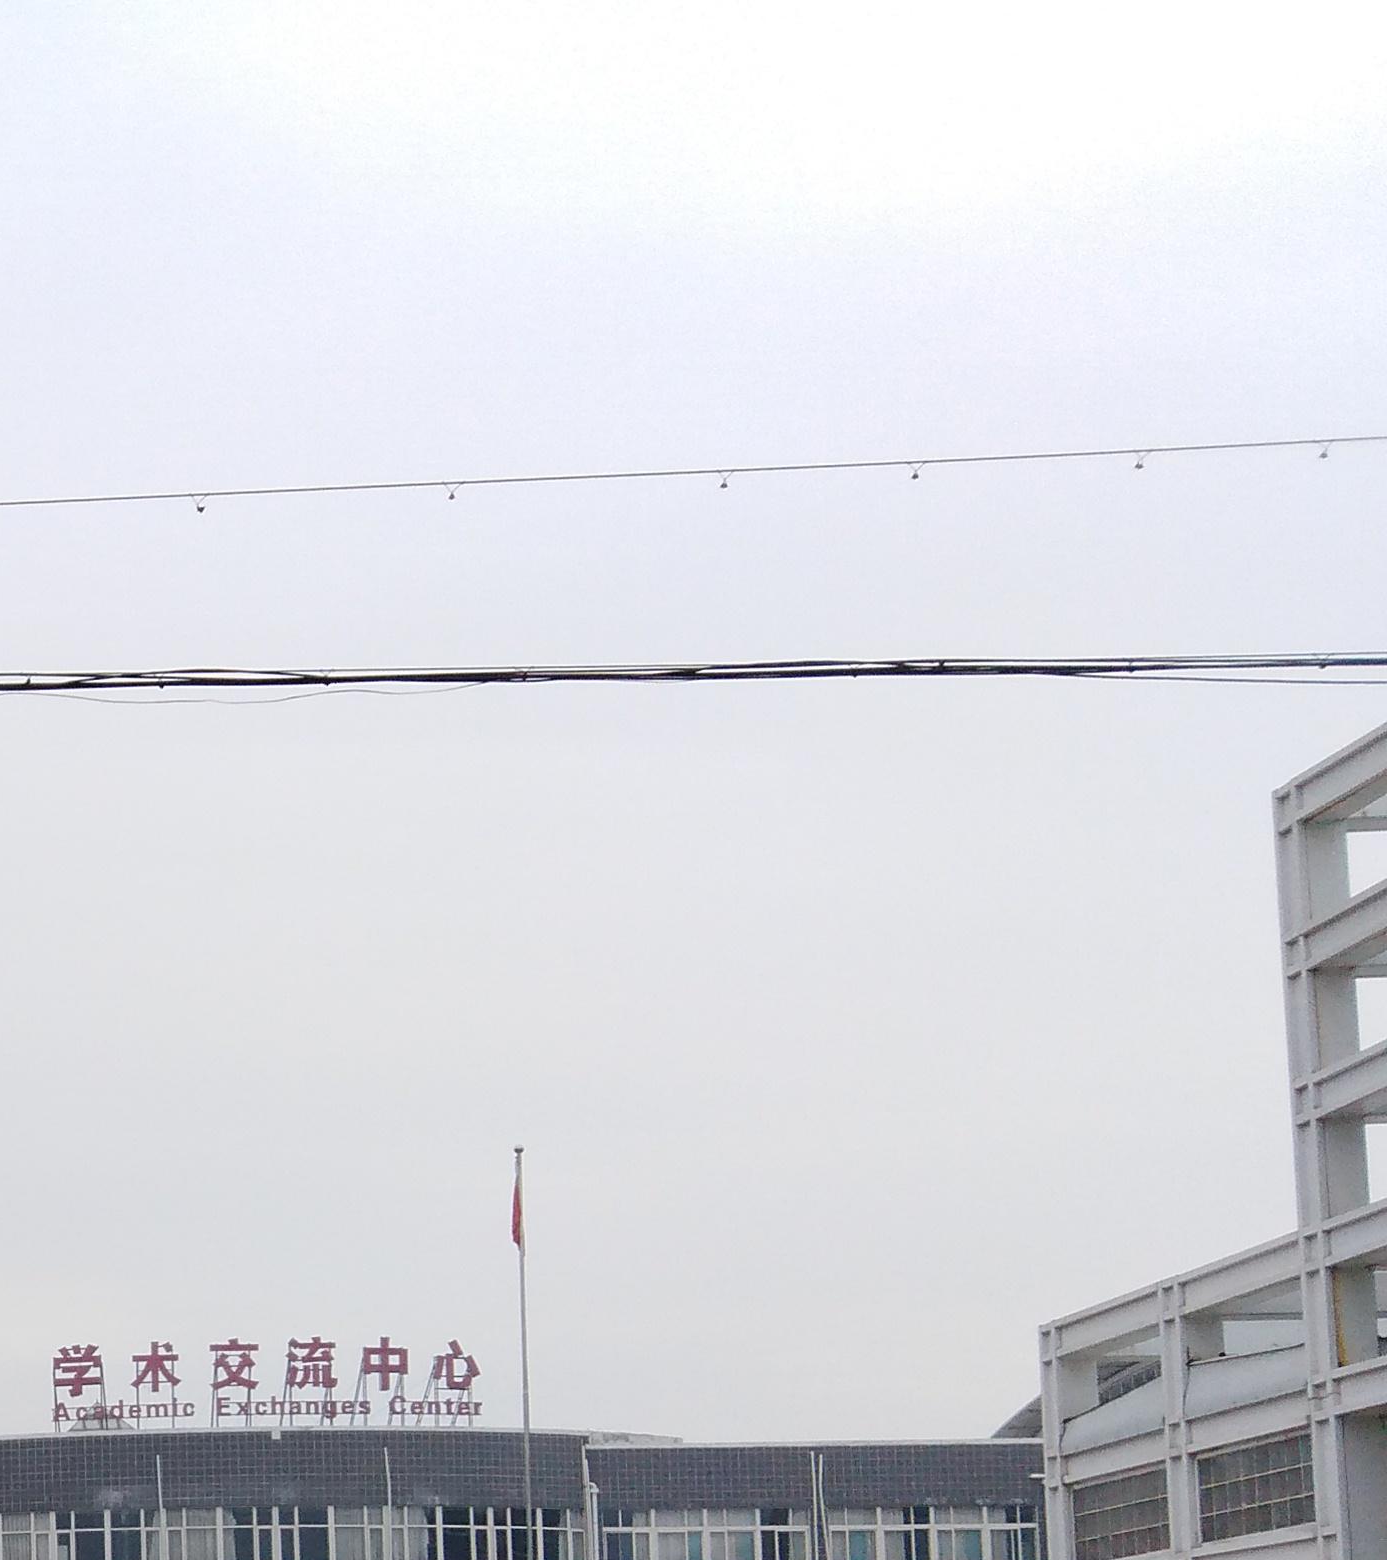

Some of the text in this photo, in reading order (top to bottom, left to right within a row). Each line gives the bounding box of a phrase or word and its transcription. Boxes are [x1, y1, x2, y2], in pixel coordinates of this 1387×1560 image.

[52, 1336, 481, 1397] 学术交流中心
[51, 1395, 483, 1422] Academic Exchanges Center
